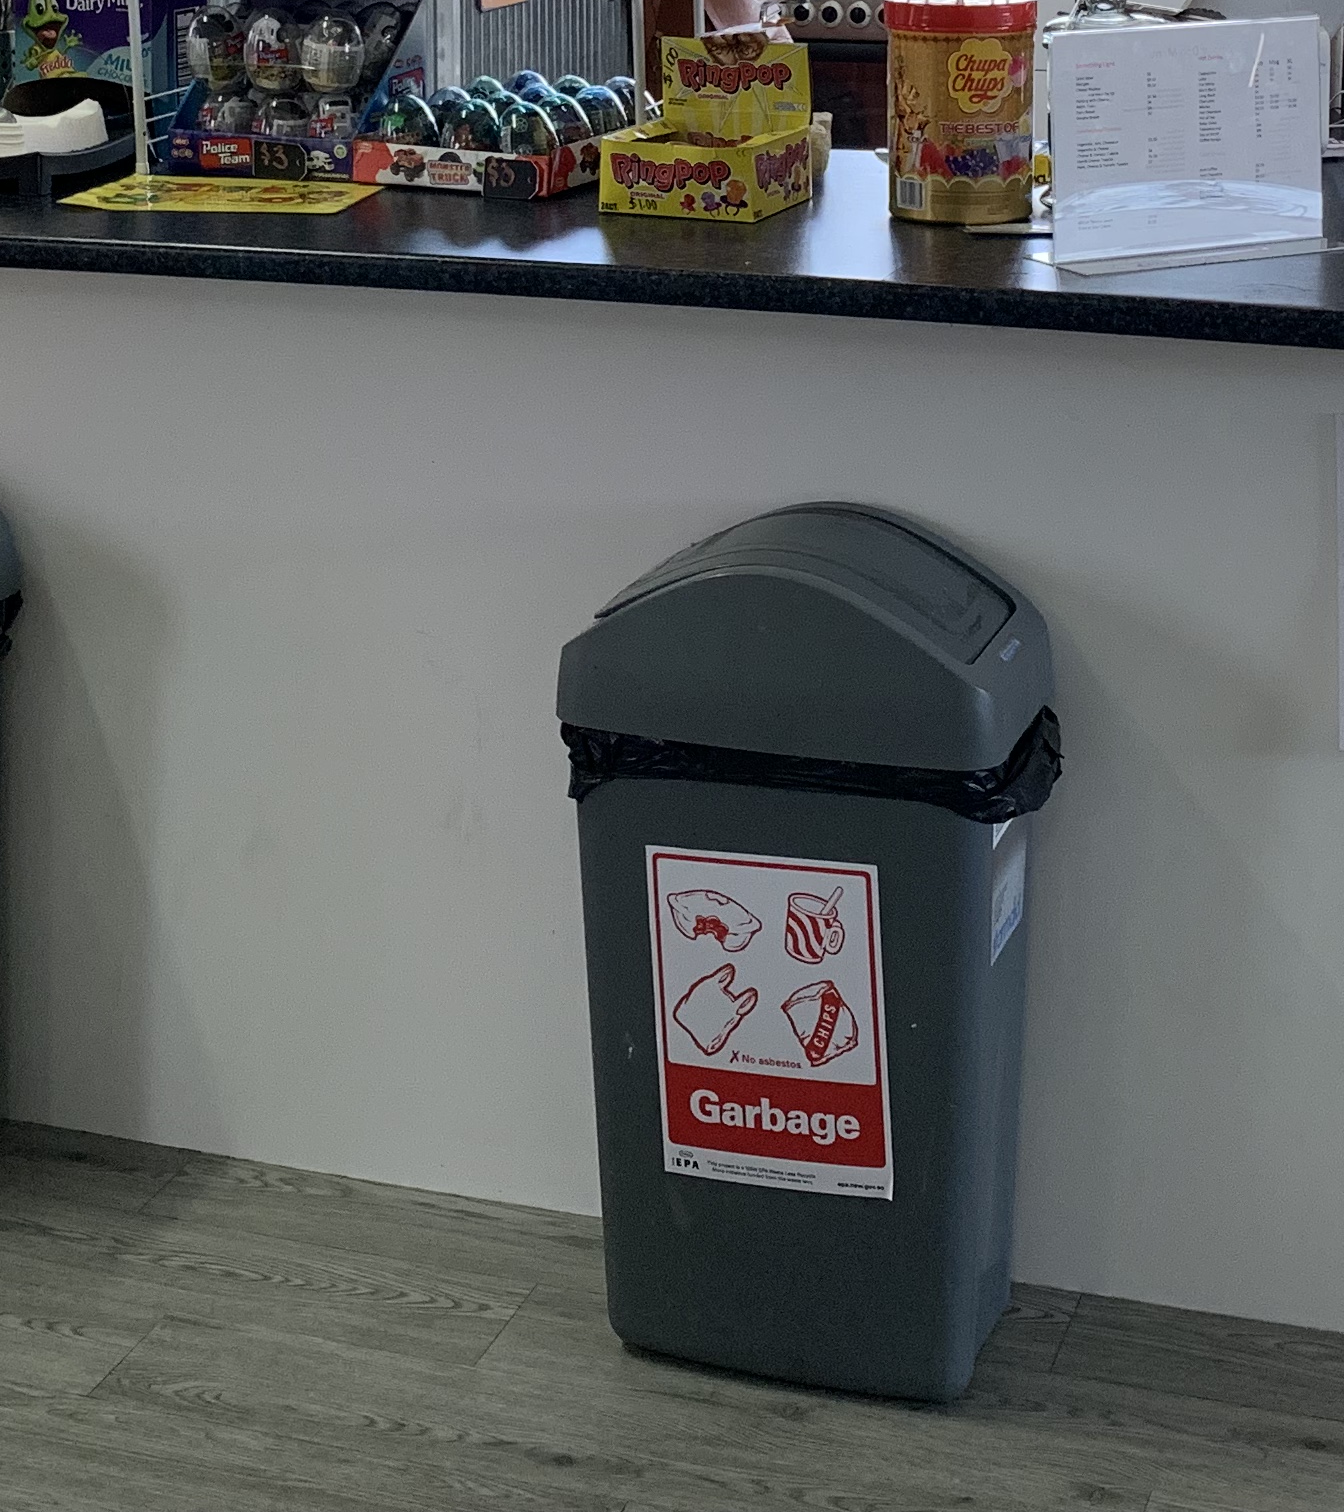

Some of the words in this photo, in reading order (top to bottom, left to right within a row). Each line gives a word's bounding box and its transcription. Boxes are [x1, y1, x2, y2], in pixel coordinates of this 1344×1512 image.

[104, 53, 133, 72] MIL
[955, 54, 1008, 78] Chupa
[952, 73, 1006, 104] Chups
[941, 122, 964, 135] THE
[966, 121, 1004, 135] BEST
[201, 141, 239, 155] Police
[219, 152, 251, 166] Team
[813, 1003, 837, 1048] CHIPS
[742, 1053, 756, 1065] No
[758, 1057, 803, 1069] asbestos
[689, 1088, 861, 1146] Garbage
[676, 1157, 700, 1171] EPA
